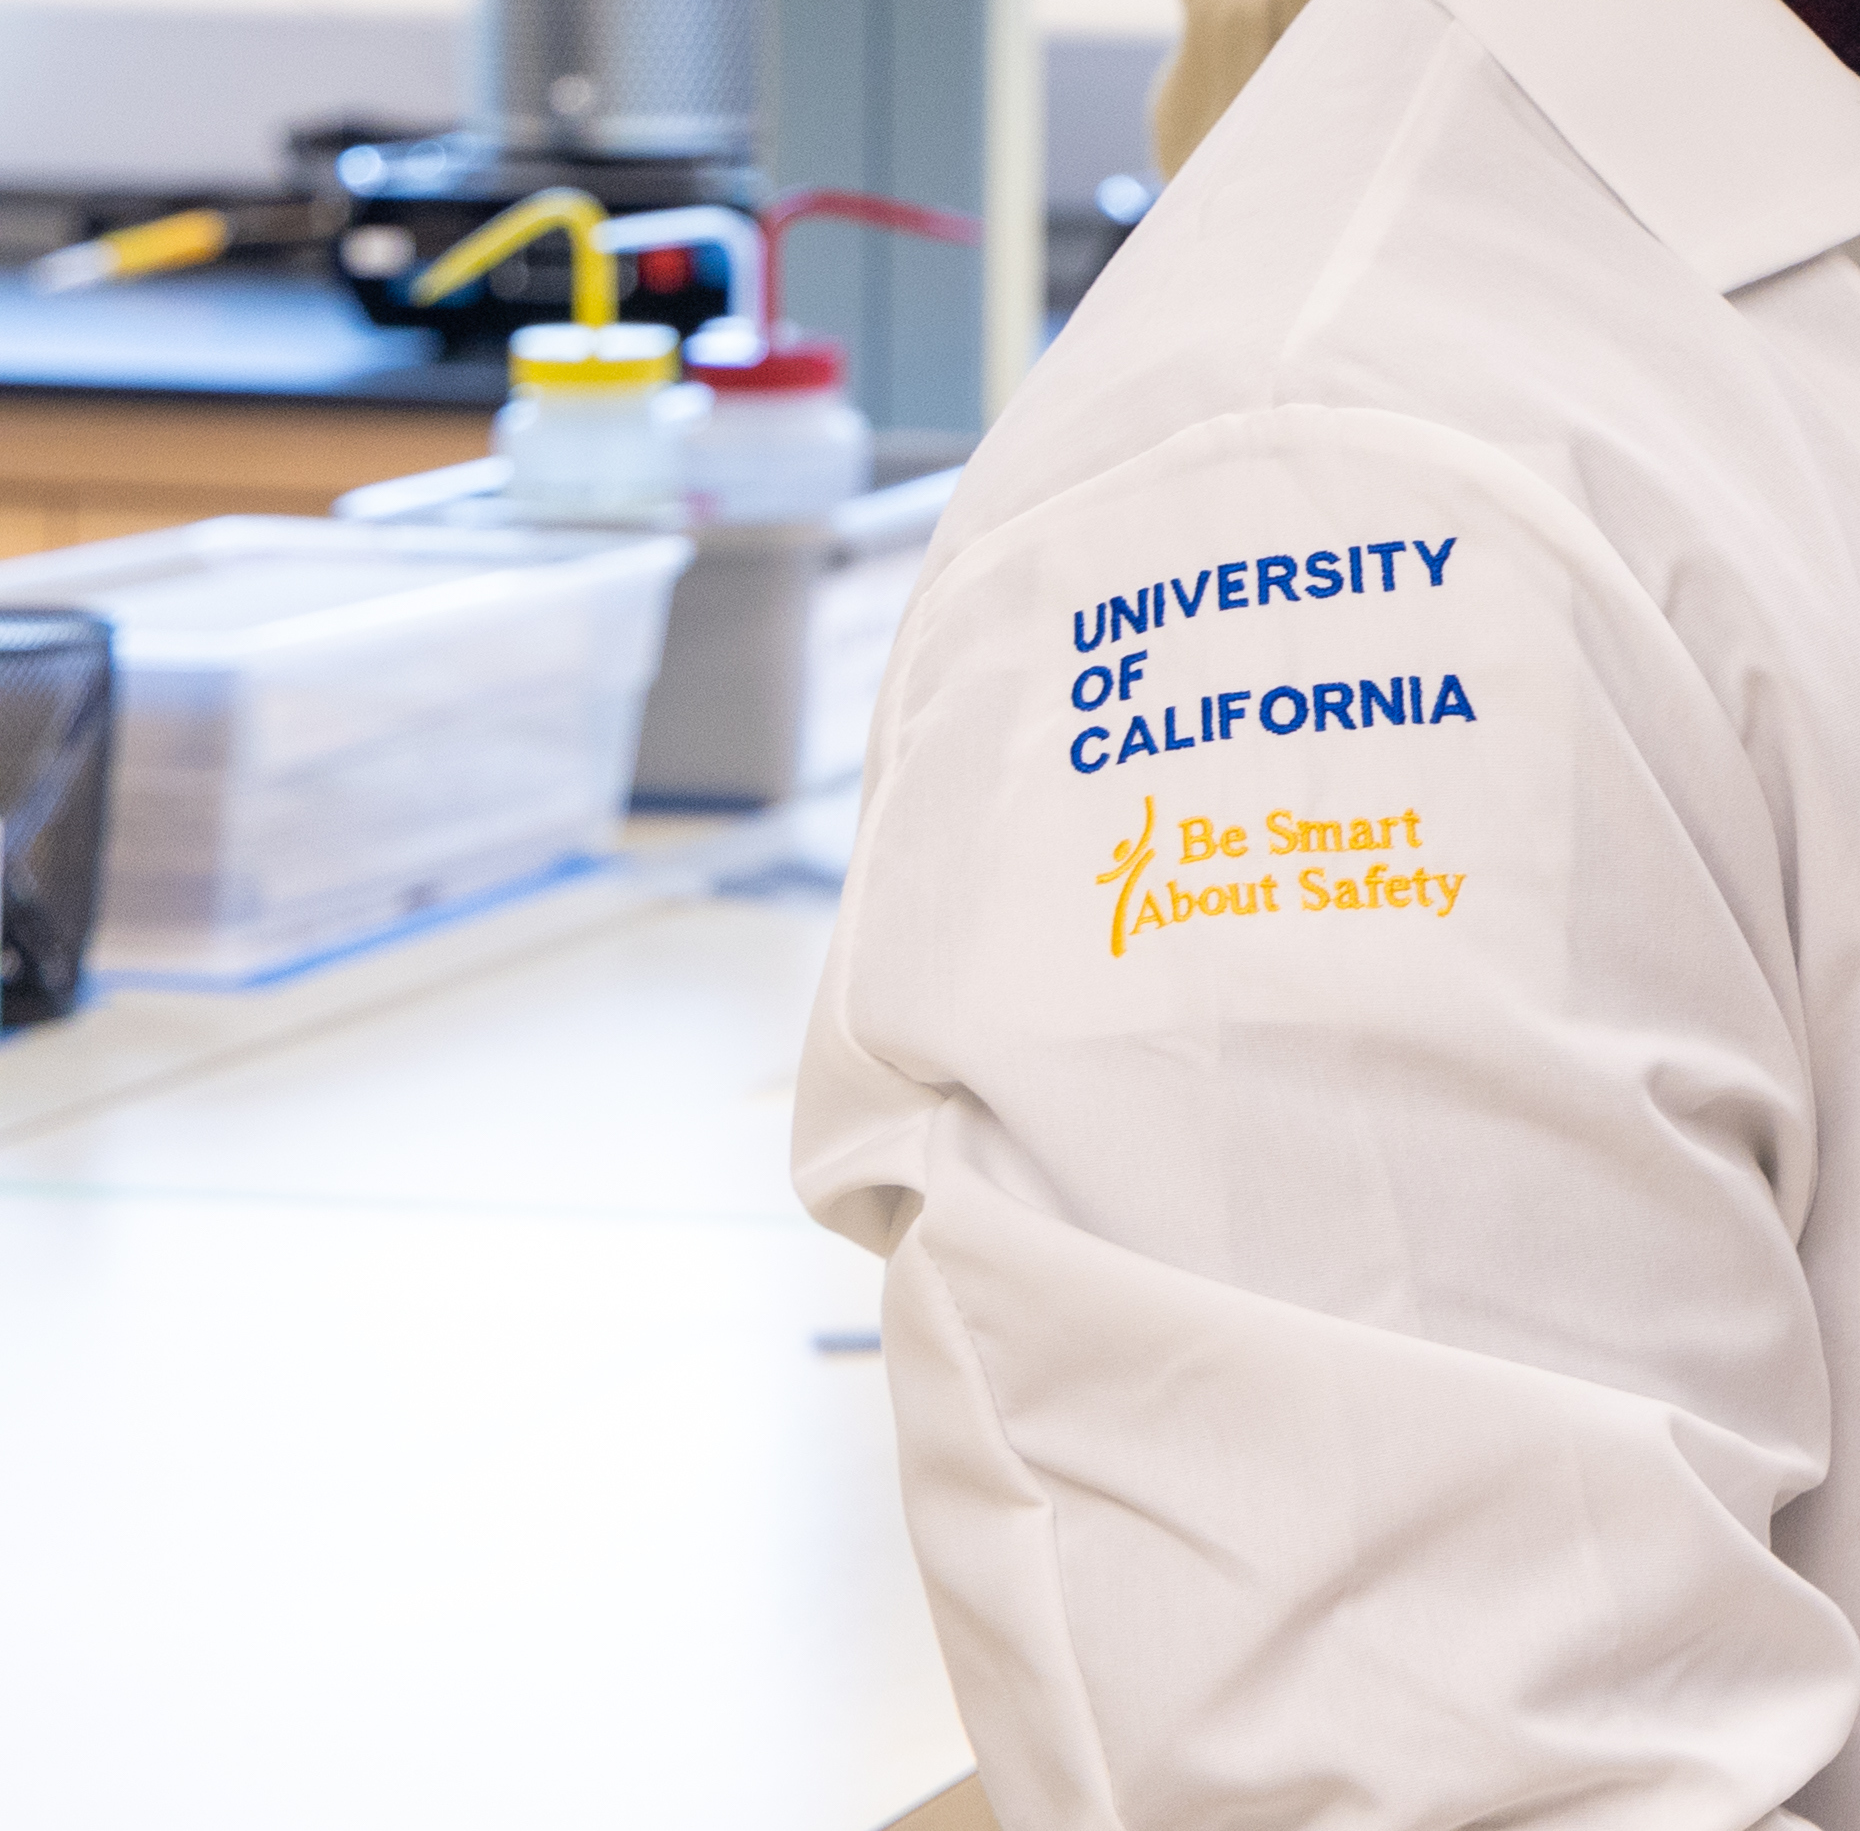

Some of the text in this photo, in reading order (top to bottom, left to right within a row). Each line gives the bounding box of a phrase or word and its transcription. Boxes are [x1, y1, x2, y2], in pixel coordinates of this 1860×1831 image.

[1074, 537, 1457, 653] UNIVERSITY
[1071, 650, 1148, 712] OF
[1070, 674, 1477, 774] CALIFORNIA
[1177, 807, 1424, 866] Be Smart
[1129, 862, 1467, 936] About Safety
